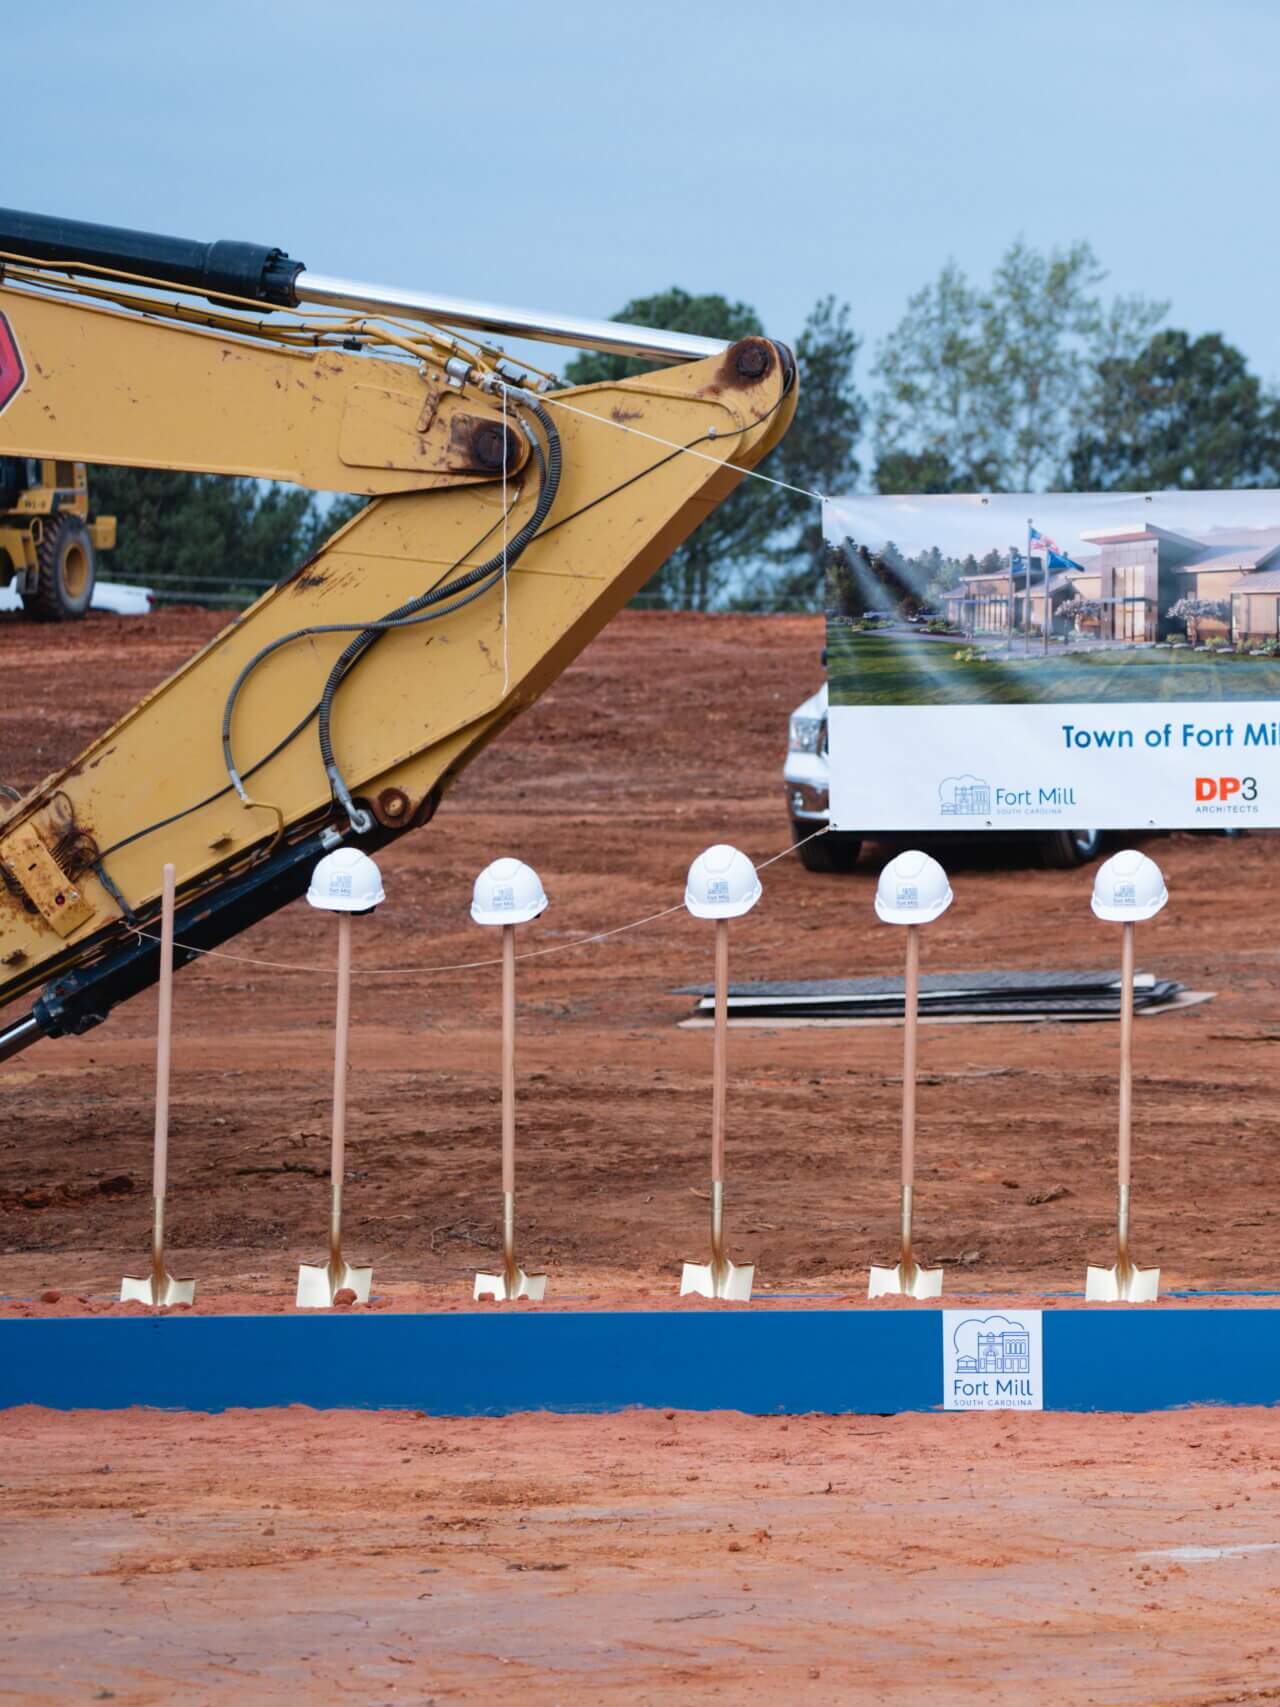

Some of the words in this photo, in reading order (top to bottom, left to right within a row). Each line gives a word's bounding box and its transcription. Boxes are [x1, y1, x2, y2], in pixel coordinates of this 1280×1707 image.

[1062, 725, 1134, 748] Town
[1145, 724, 1172, 747] of
[1183, 723, 1234, 747] Fort
[996, 788, 1032, 805] Fort
[1039, 787, 1077, 805] Mill
[1195, 777, 1258, 801] DP3
[1195, 805, 1259, 813] ARCHITECTS
[954, 1379, 989, 1396] Fort
[996, 1379, 1034, 1396] Mill
